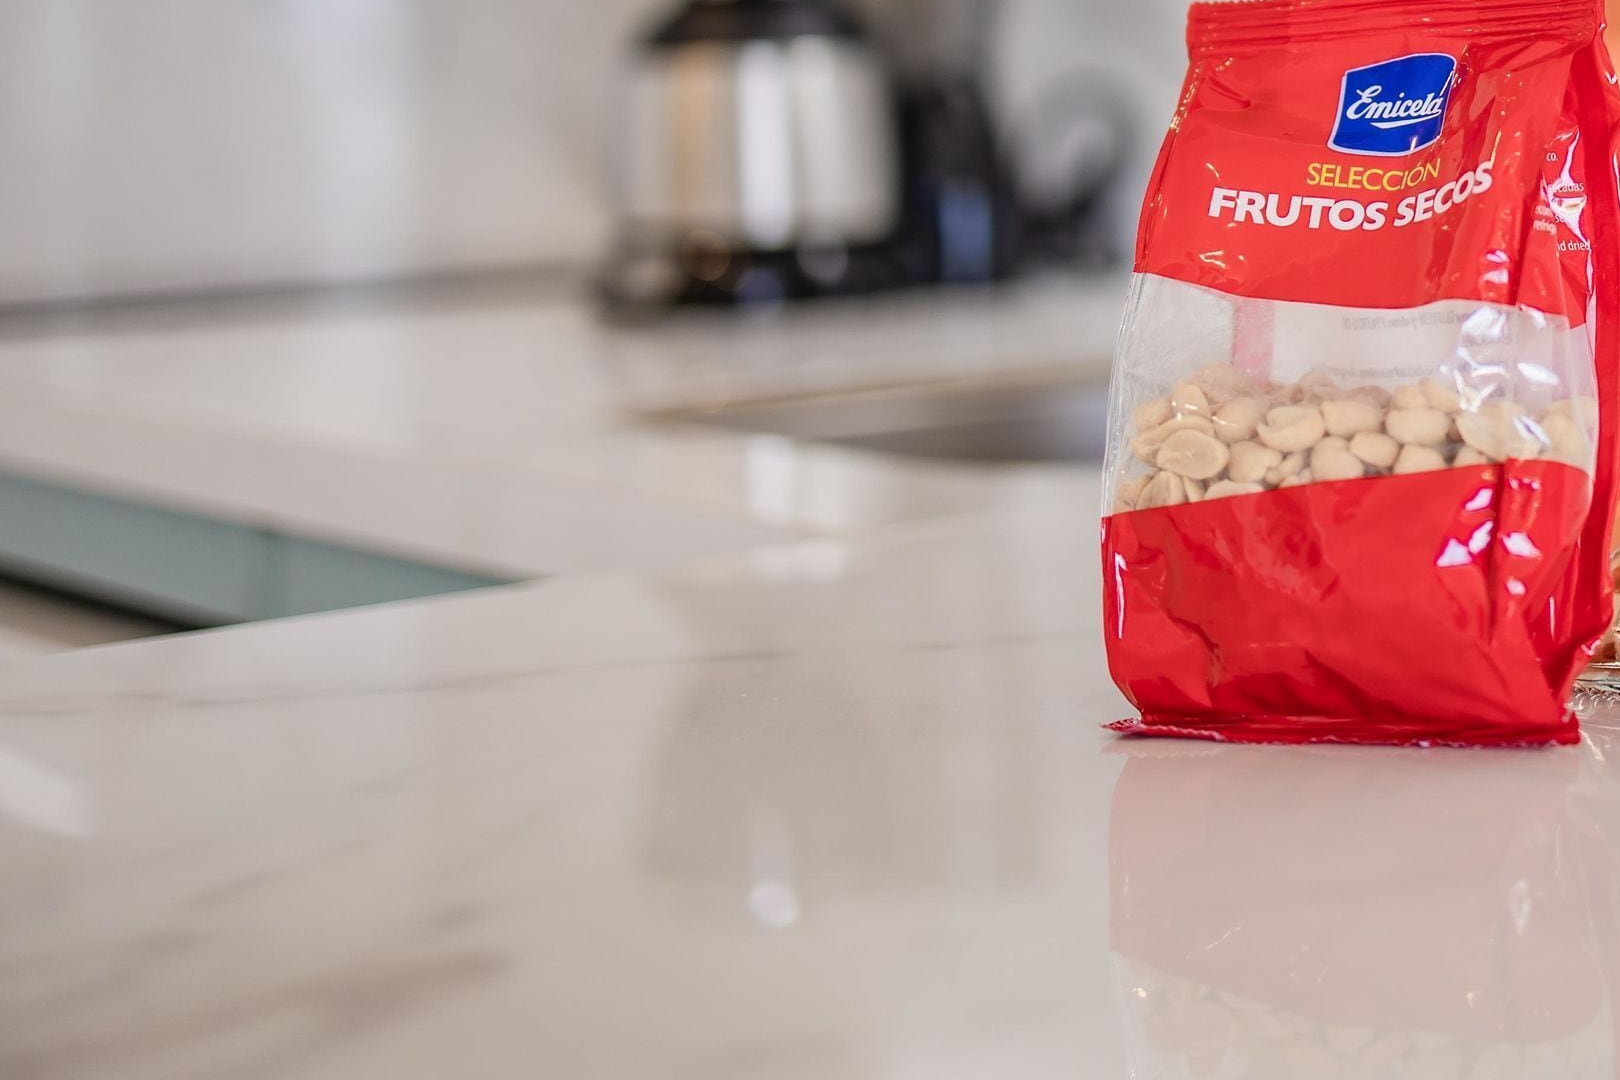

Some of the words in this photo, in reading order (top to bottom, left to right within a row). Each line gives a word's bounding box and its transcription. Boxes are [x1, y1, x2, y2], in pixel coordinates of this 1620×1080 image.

[1346, 84, 1444, 129] Emicela
[1208, 187, 1389, 231] FRUTOS
[1393, 161, 1493, 227] SECOS
[1306, 158, 1441, 191] SELECCIÓN
